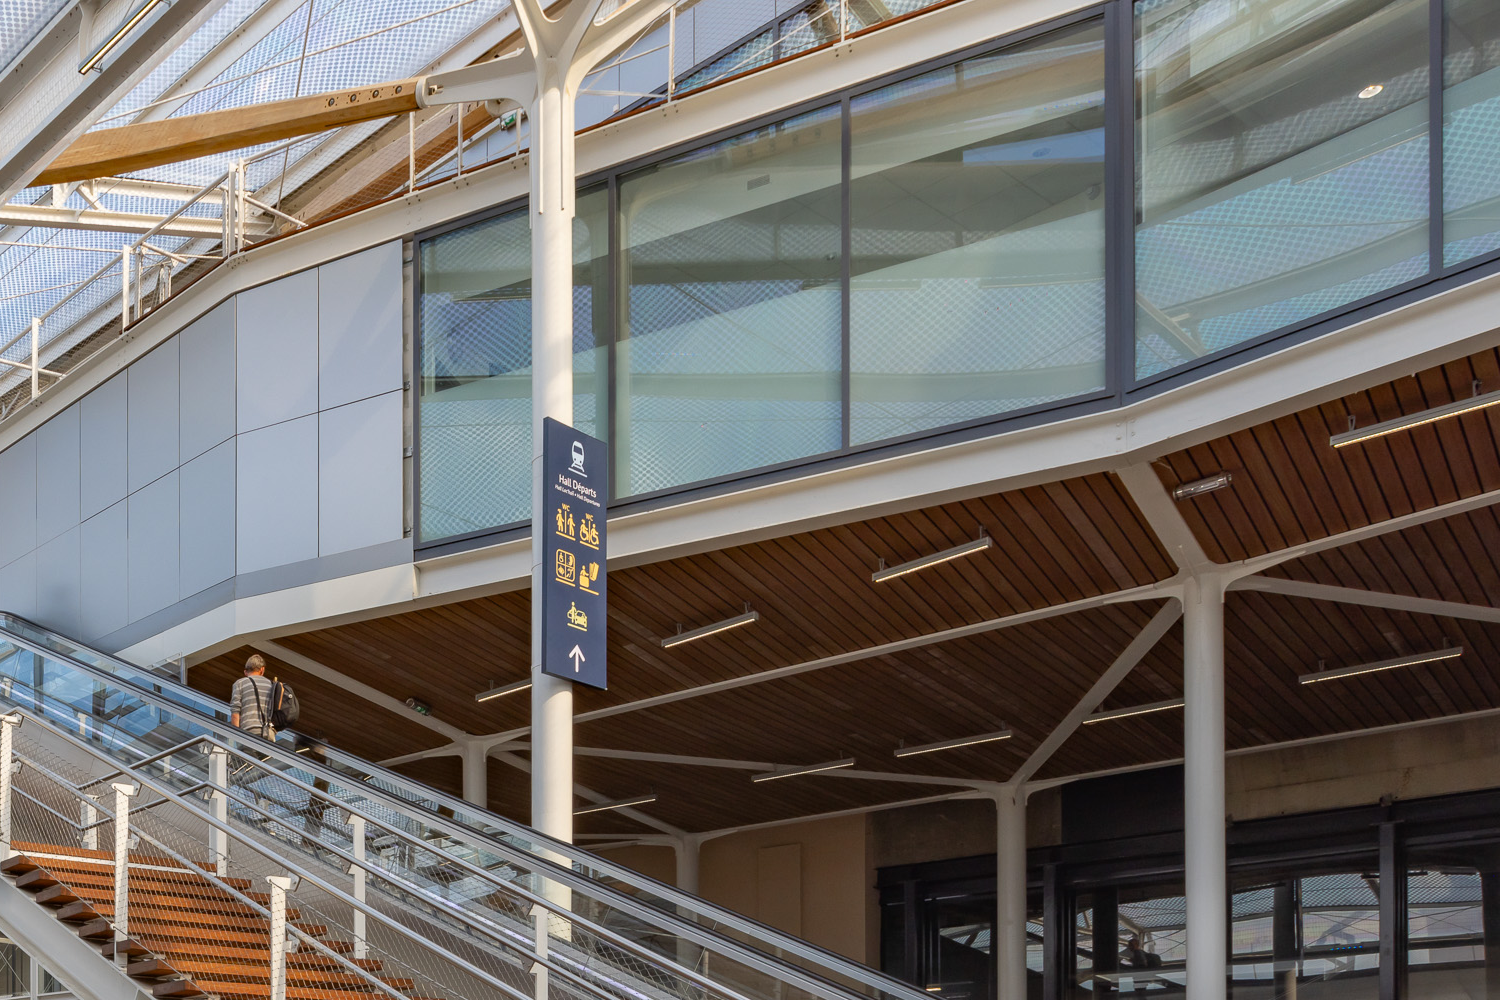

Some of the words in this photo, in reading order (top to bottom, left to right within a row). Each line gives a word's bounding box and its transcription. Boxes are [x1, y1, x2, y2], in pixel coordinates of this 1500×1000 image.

[559, 474, 572, 487] Hall
[573, 480, 596, 498] Départs
[562, 503, 570, 512] WC
[586, 513, 594, 521] WC
